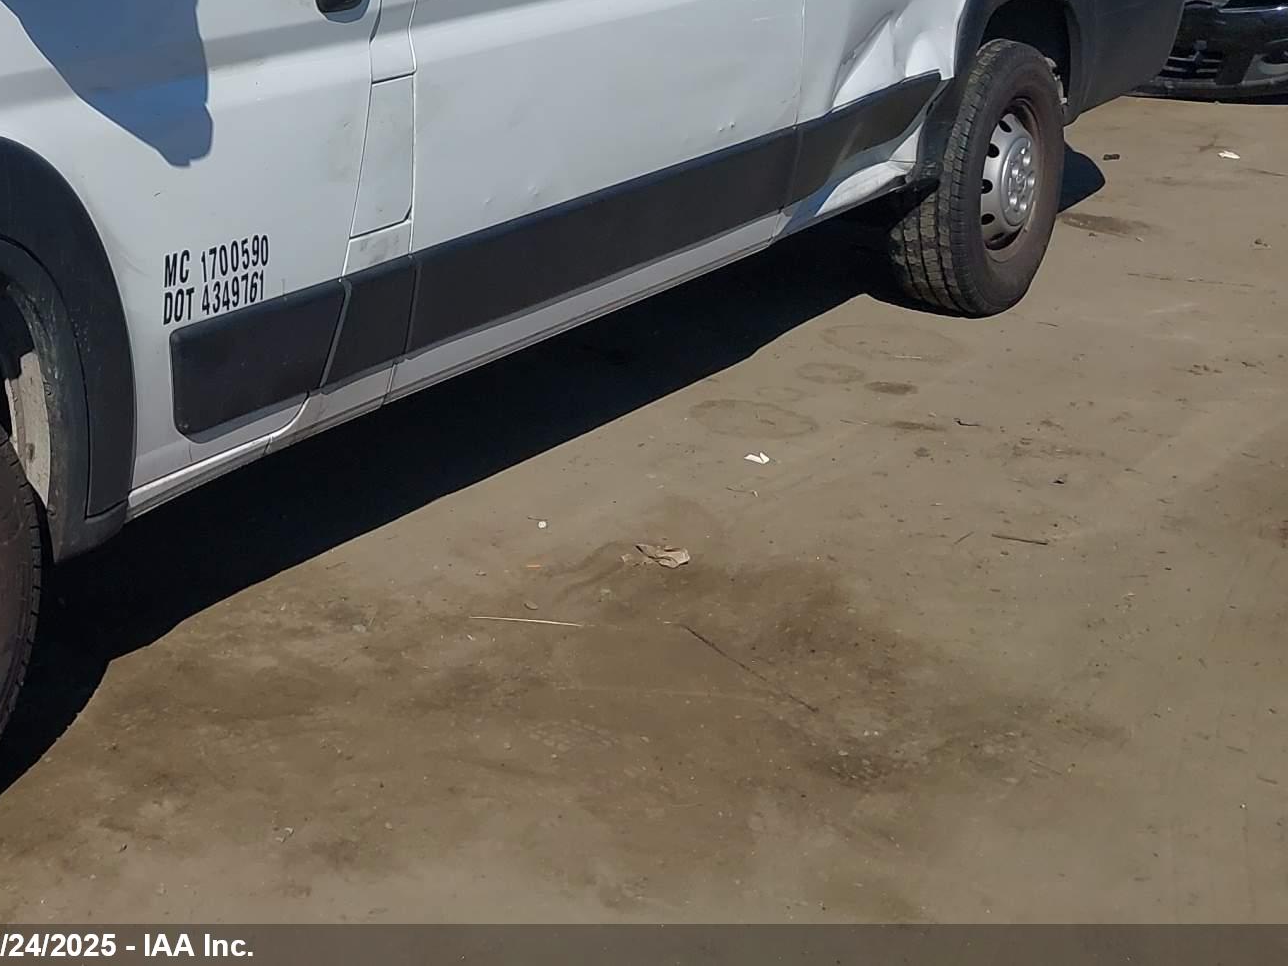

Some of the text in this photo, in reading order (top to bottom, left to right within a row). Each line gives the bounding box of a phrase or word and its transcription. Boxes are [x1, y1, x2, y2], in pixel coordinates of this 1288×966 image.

[163, 234, 269, 288] MC 1700590
[163, 269, 264, 326] DOT 4349761
